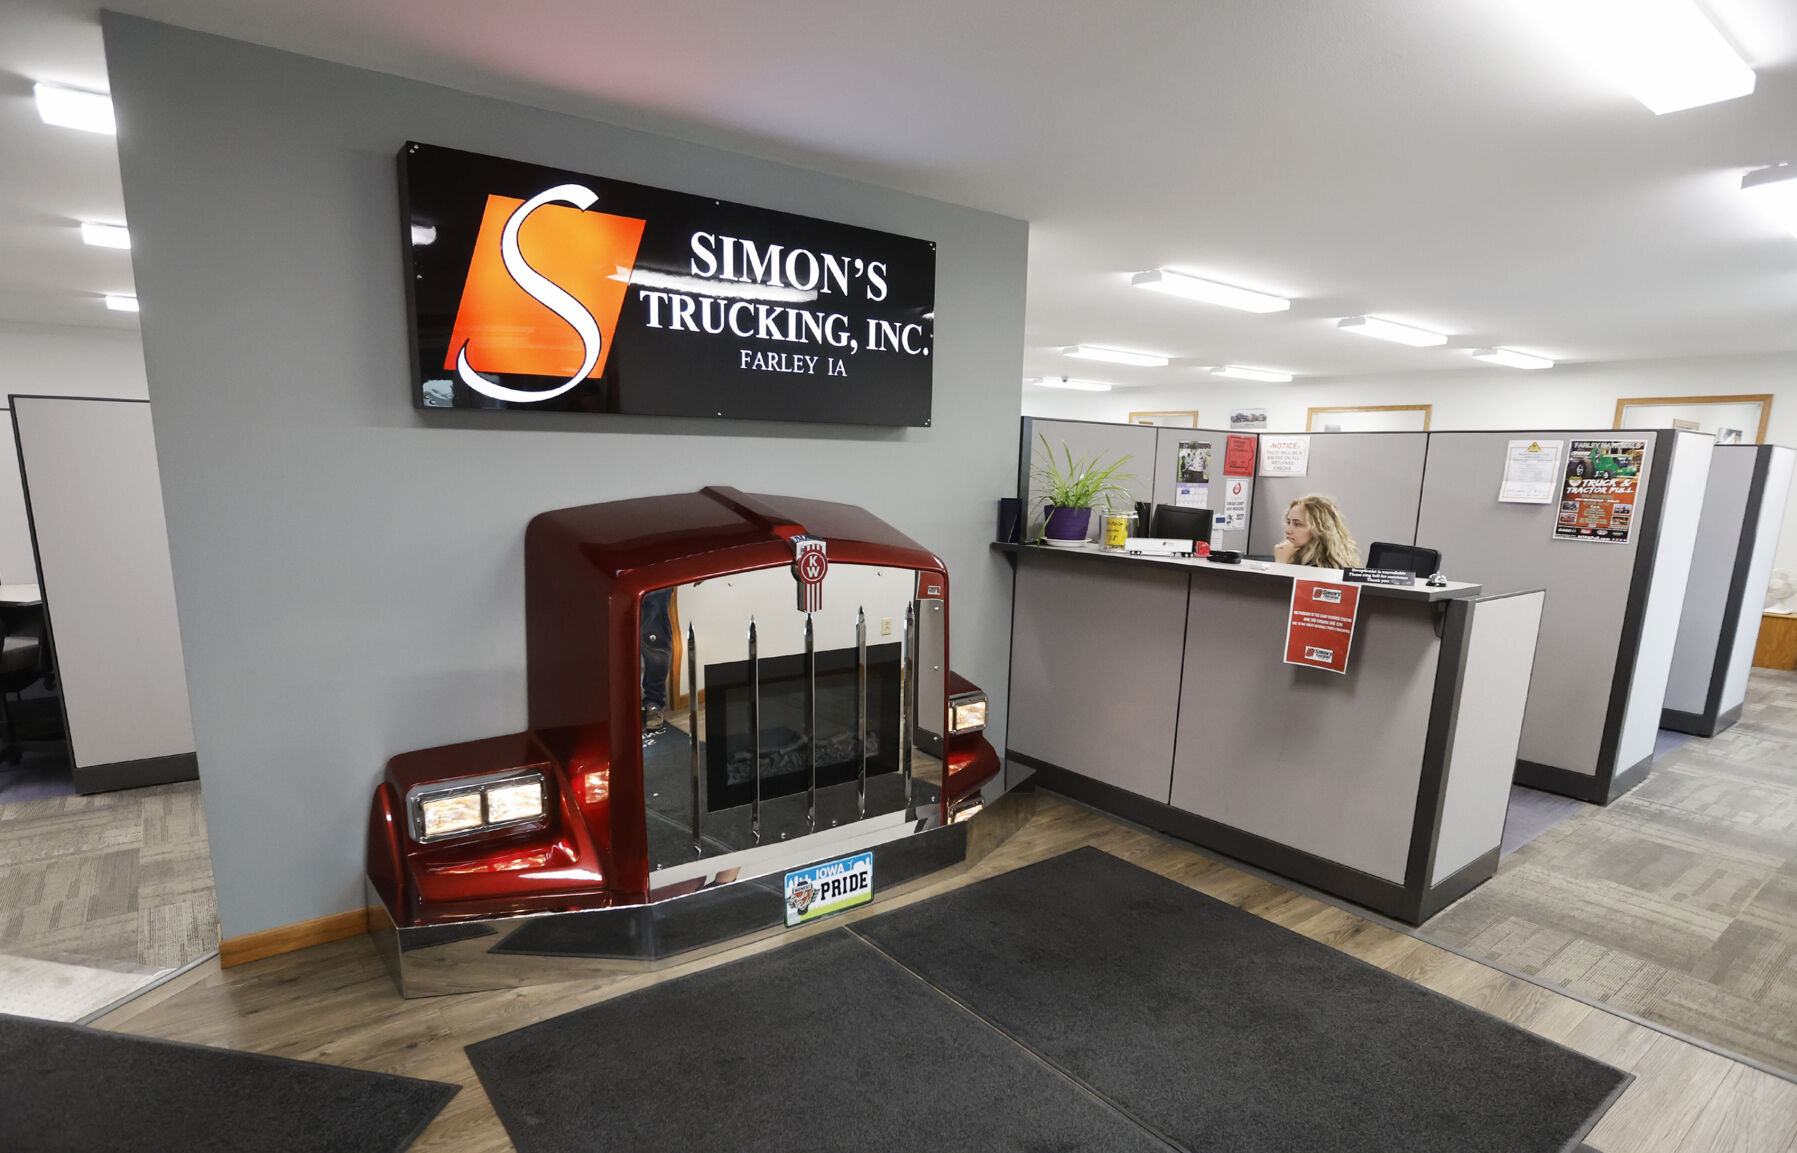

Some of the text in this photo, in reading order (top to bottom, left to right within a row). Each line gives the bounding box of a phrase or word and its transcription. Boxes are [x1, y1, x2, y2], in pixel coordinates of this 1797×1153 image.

[690, 231, 888, 302] SIMON'S
[458, 184, 600, 402] S
[639, 290, 930, 356] TRUCKING, INC.
[740, 350, 848, 377] FARLEY IA
[1582, 479, 1632, 487] TRUCK &
[816, 863, 845, 880] IOWA
[821, 871, 868, 900] PRIDE
